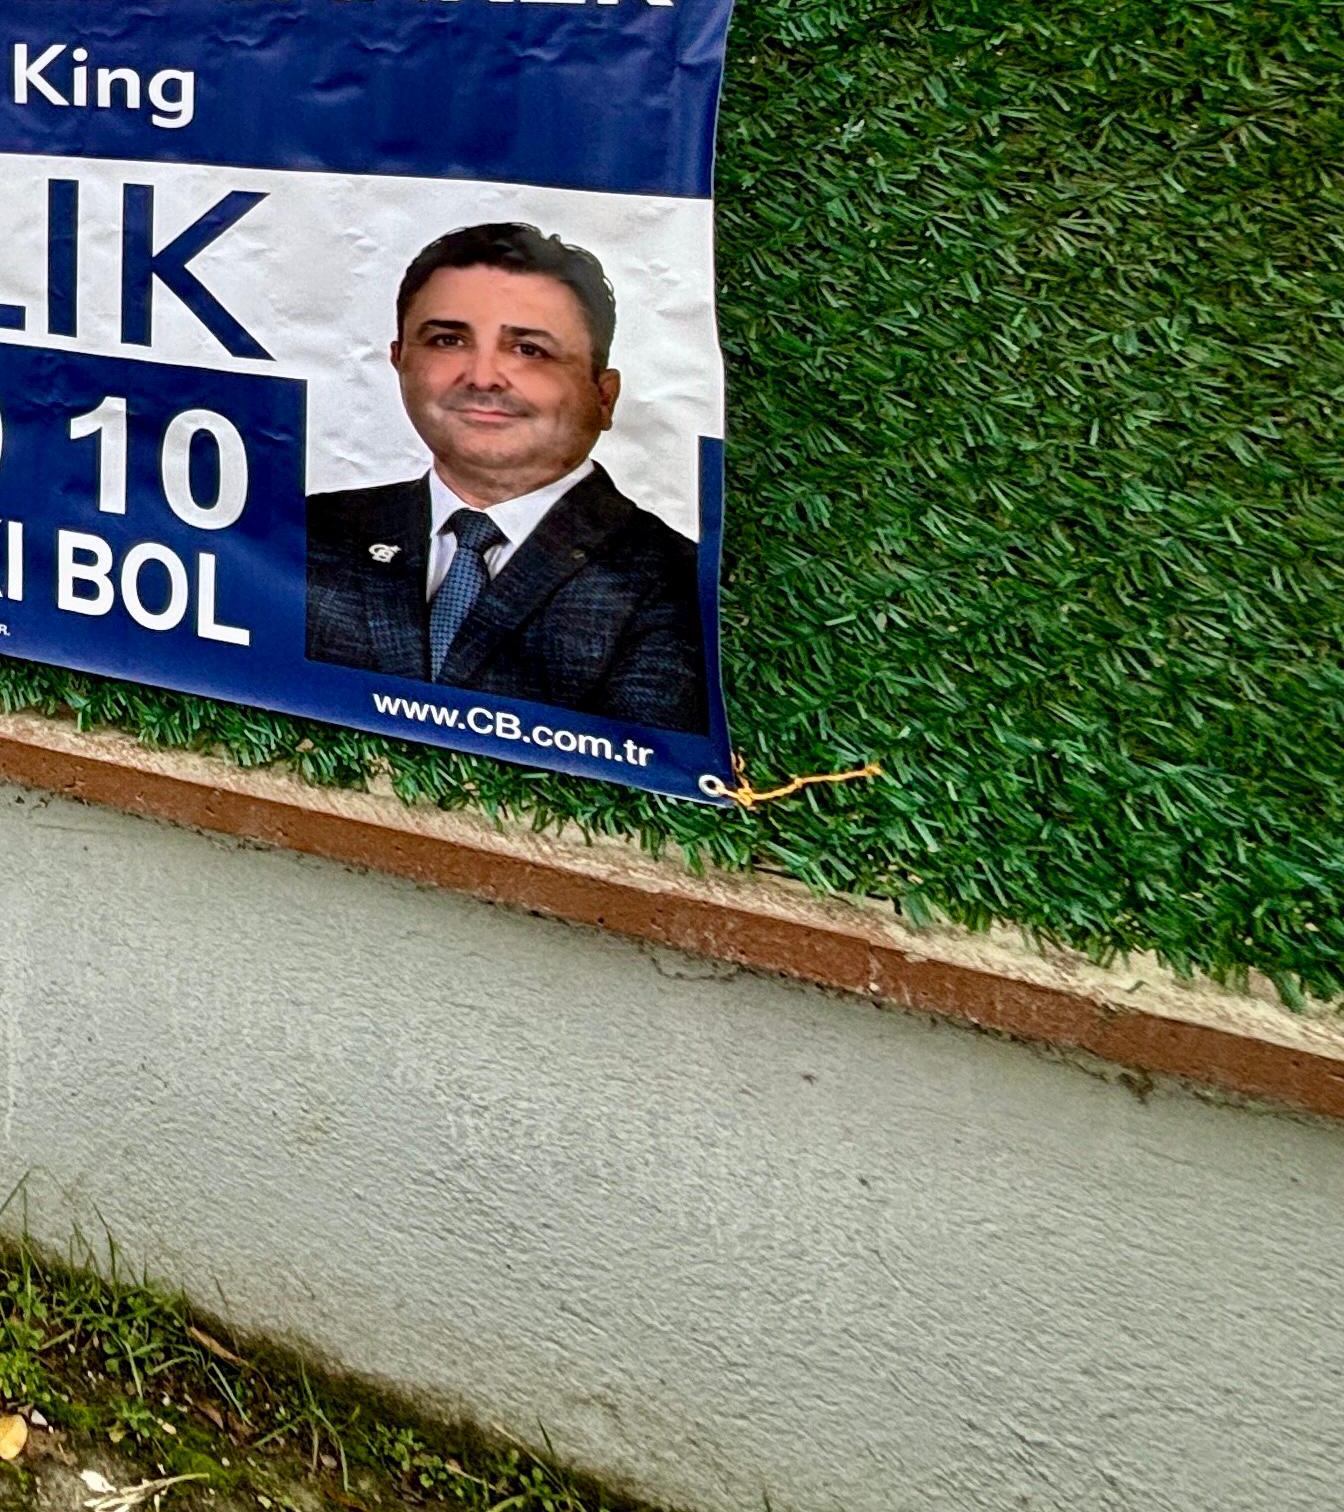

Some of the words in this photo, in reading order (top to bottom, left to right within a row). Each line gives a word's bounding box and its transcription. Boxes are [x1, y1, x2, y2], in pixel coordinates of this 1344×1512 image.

[14, 43, 196, 129] King
[70, 395, 249, 531] 10
[57, 529, 251, 647] BOL
[372, 692, 654, 768] www.CB.com.tr
